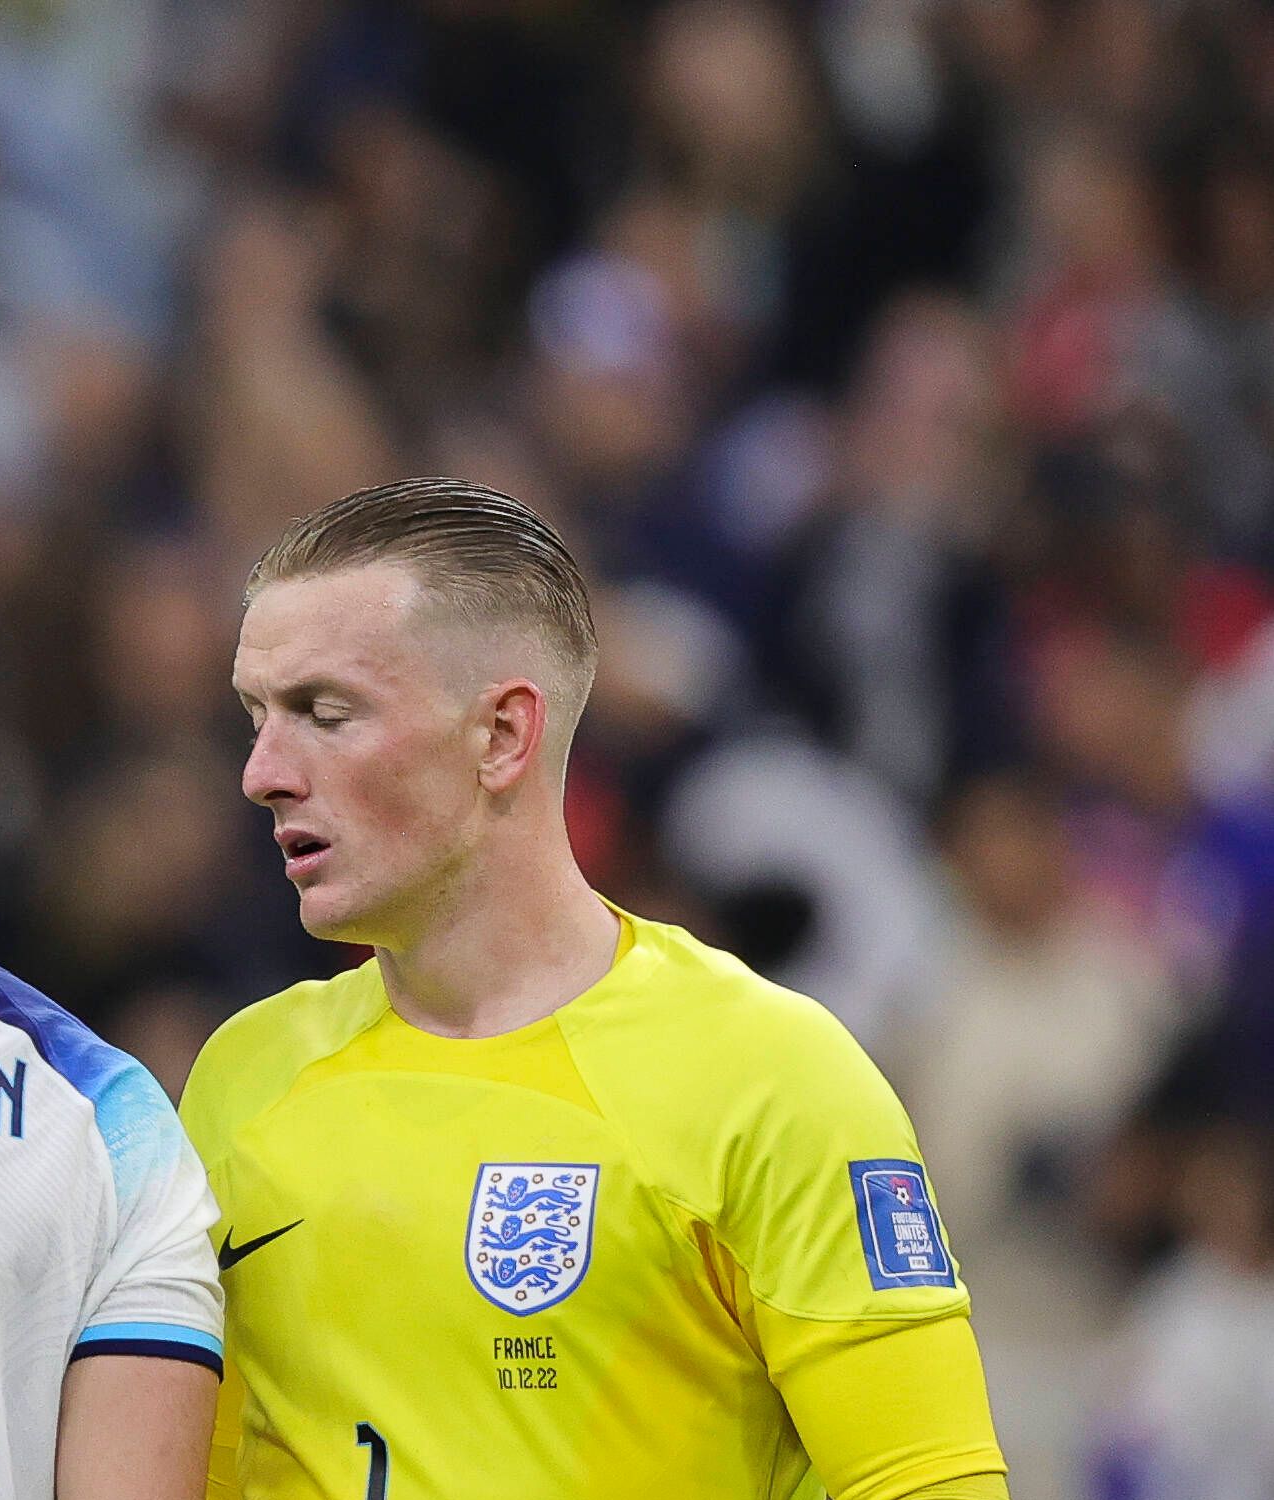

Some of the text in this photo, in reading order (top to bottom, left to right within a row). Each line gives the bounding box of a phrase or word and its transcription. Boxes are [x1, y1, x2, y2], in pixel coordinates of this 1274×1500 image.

[893, 1224, 929, 1241] UNITES
[493, 1336, 556, 1360] FRANCE
[496, 1367, 558, 1390] 10.12.22
